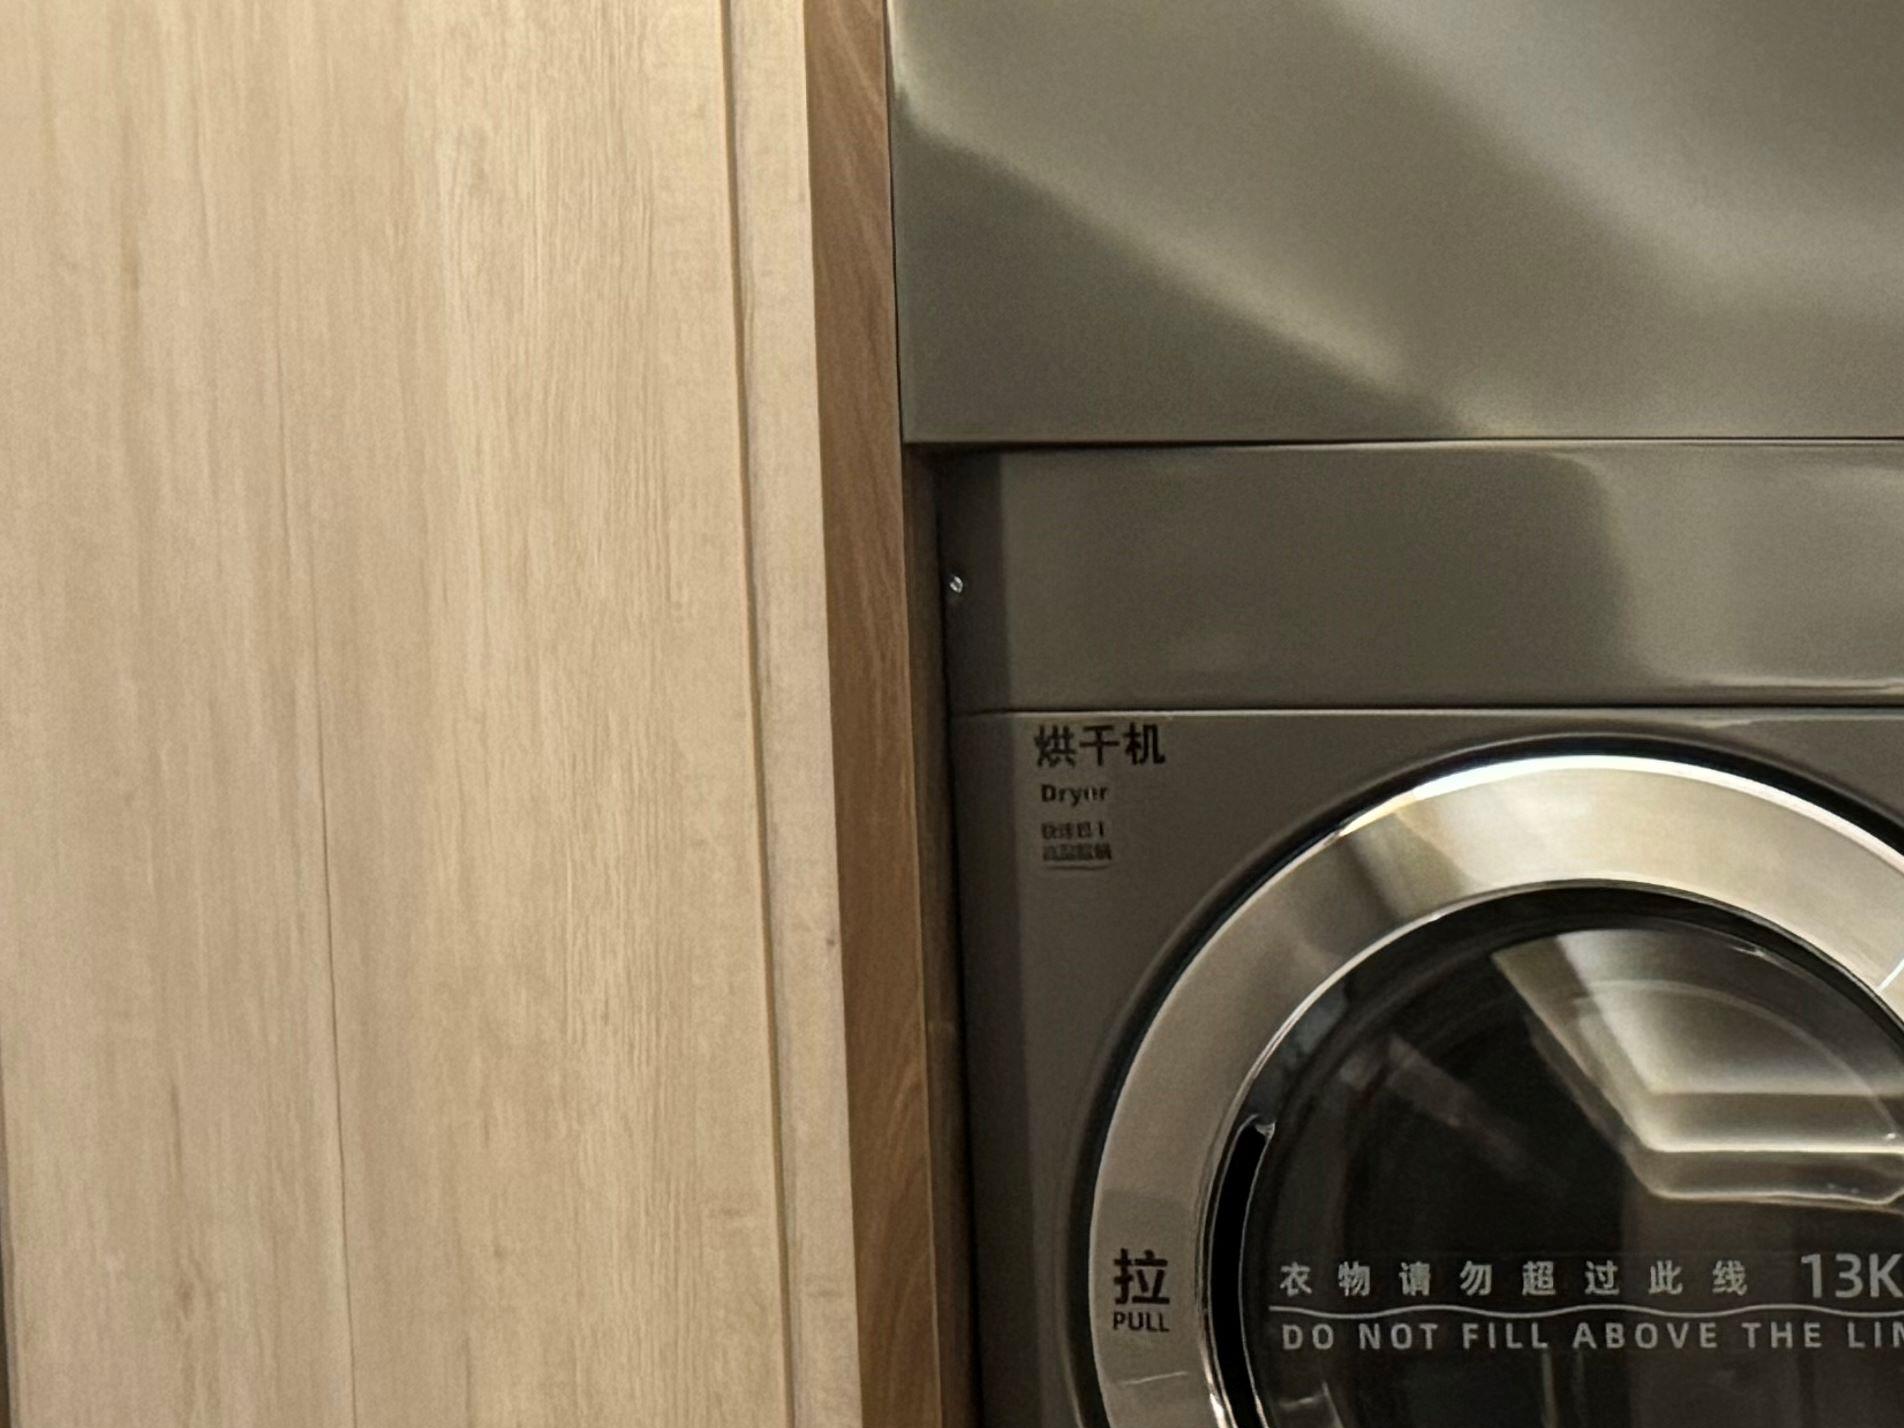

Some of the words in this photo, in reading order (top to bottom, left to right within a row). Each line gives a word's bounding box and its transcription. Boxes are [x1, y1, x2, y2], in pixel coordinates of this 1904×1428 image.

[1034, 722, 1166, 767] 烘干机
[1041, 784, 1108, 806] Dryer
[1114, 1249, 1169, 1304] 拉
[1280, 1260, 1747, 1296] 衣物请勿超过此线
[1114, 1312, 1169, 1332] PULL
[1283, 1324, 1333, 1349] DO
[1359, 1323, 1437, 1349] NOT
[1463, 1323, 1548, 1349] FILL
[1574, 1323, 1716, 1348] ABOVE
[1742, 1322, 1821, 1348] THE
